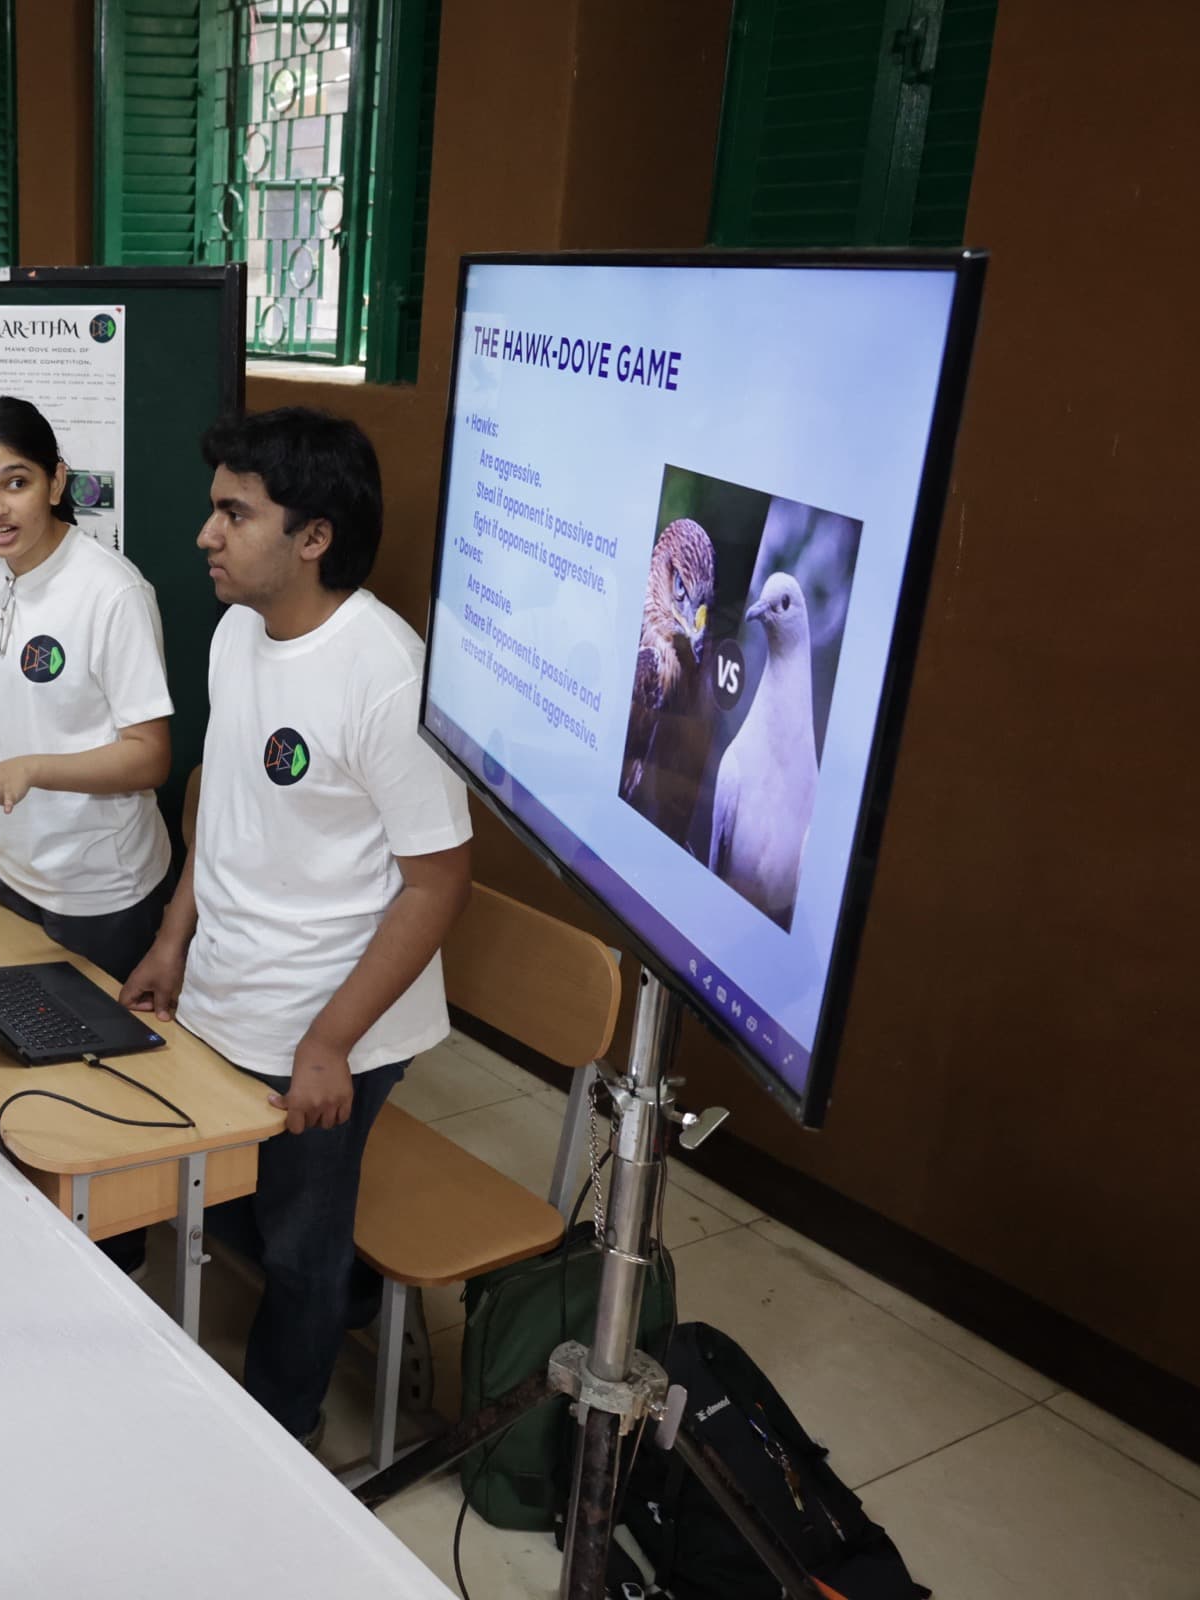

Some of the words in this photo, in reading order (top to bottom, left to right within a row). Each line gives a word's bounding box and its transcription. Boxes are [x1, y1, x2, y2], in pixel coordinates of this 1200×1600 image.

[474, 326, 500, 359] THE
[502, 329, 612, 379] HAWK-DOVE
[616, 345, 682, 391] GAME
[471, 413, 499, 438] Hawks:
[479, 449, 493, 468] Are
[494, 456, 542, 488] aggressive.
[476, 480, 496, 504] Steal
[496, 487, 503, 506] if
[503, 495, 545, 528] opponent
[544, 507, 553, 530] is
[553, 517, 594, 548] passive
[594, 535, 618, 559] and
[459, 536, 484, 565] Doves:
[473, 511, 492, 537] fight
[491, 519, 498, 538] if
[498, 527, 540, 560] opponent
[539, 541, 548, 564] is
[548, 551, 606, 595] aggressive.
[467, 573, 481, 595] Are
[480, 584, 513, 616] passive.
[464, 603, 486, 631] Share
[486, 616, 493, 636] if
[492, 626, 532, 665] opponent
[531, 647, 541, 670] is
[540, 658, 578, 696] passive
[579, 685, 602, 712] and
[717, 654, 740, 694] VS
[461, 636, 487, 665] retreat
[486, 650, 493, 671] if
[493, 660, 533, 700] opponent
[532, 684, 541, 706] is
[542, 697, 599, 751] aggressive.
